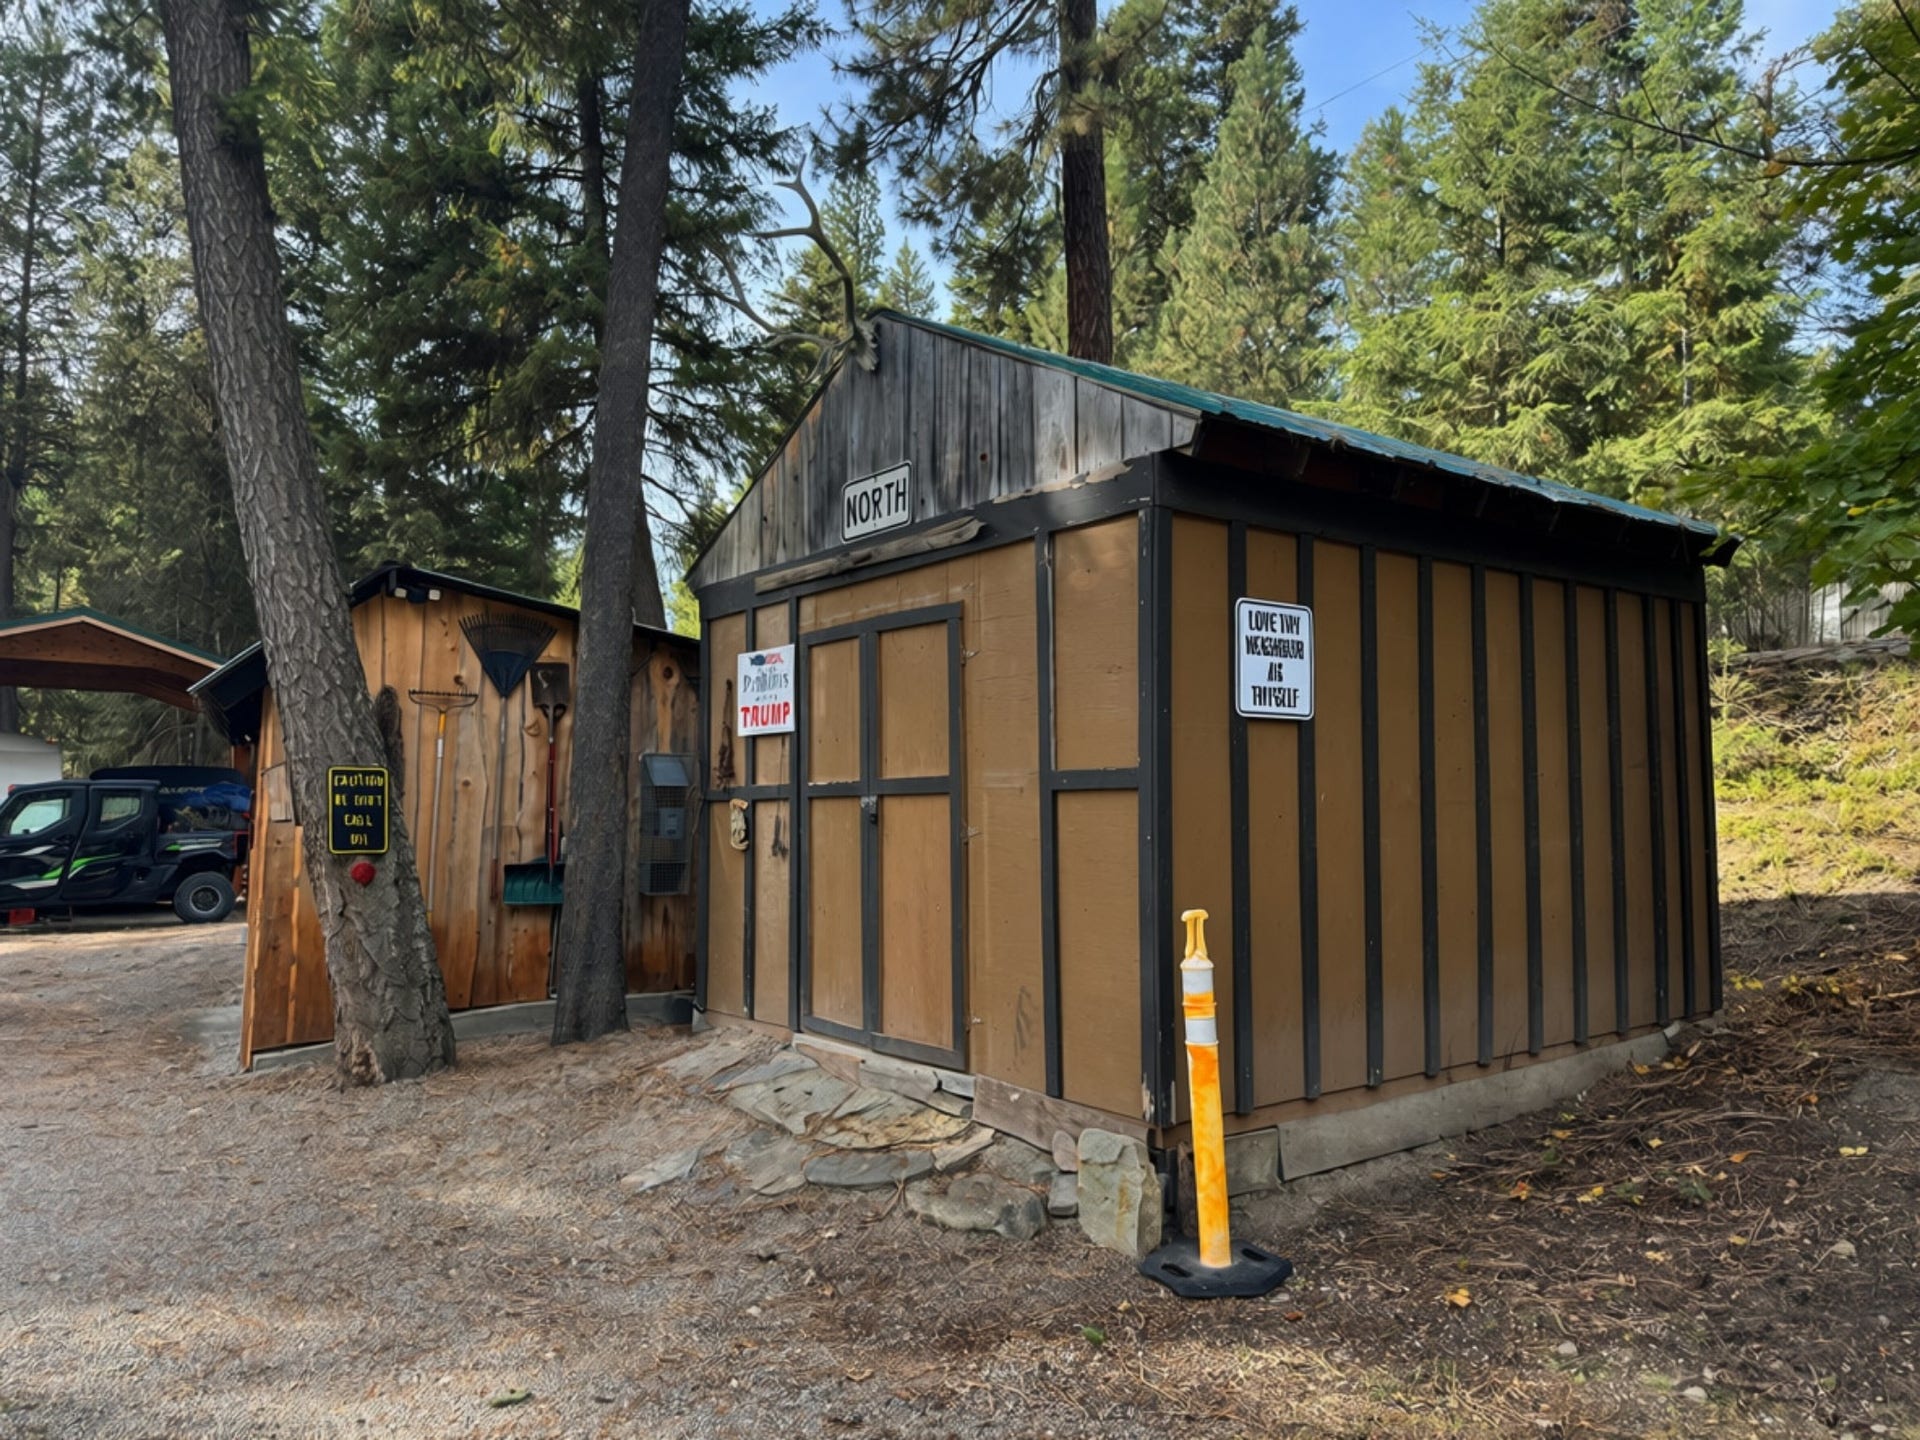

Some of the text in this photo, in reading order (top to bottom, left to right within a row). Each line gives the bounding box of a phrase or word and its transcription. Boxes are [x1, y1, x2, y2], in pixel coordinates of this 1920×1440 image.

[846, 477, 906, 529] NORTH
[1248, 610, 1277, 633] LOVE
[741, 701, 790, 728] TRUMP
